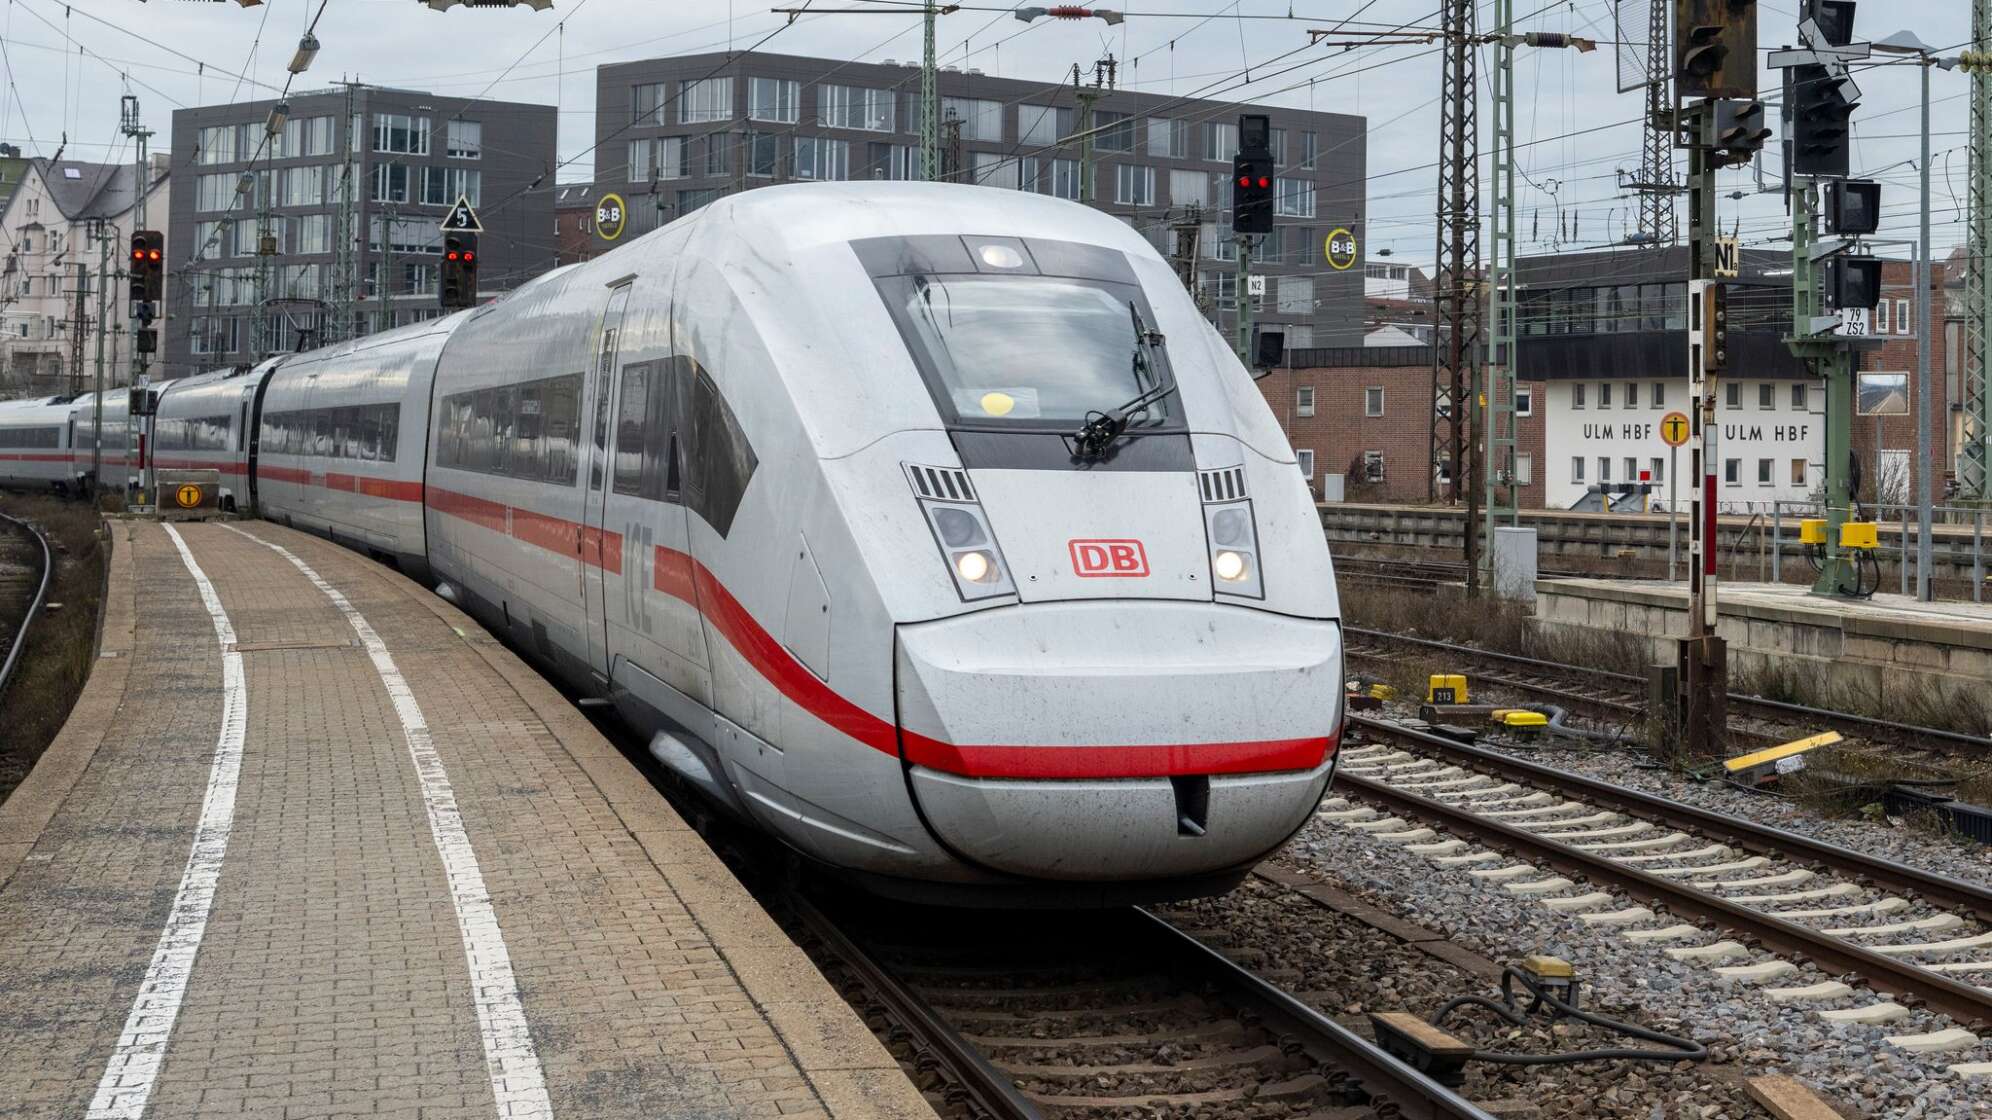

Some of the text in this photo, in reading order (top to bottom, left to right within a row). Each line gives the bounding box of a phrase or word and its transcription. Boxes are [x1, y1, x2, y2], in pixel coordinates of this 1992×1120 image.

[457, 207, 467, 227] 5
[598, 208, 620, 222] B&B
[1331, 240, 1354, 254] B&B
[1251, 280, 1261, 290] N2
[1850, 309, 1861, 321] 79
[1583, 423, 1651, 440] ULM HBF
[1725, 424, 1808, 441] ULM HBF
[1076, 543, 1141, 572] DB
[624, 521, 653, 635] ICE
